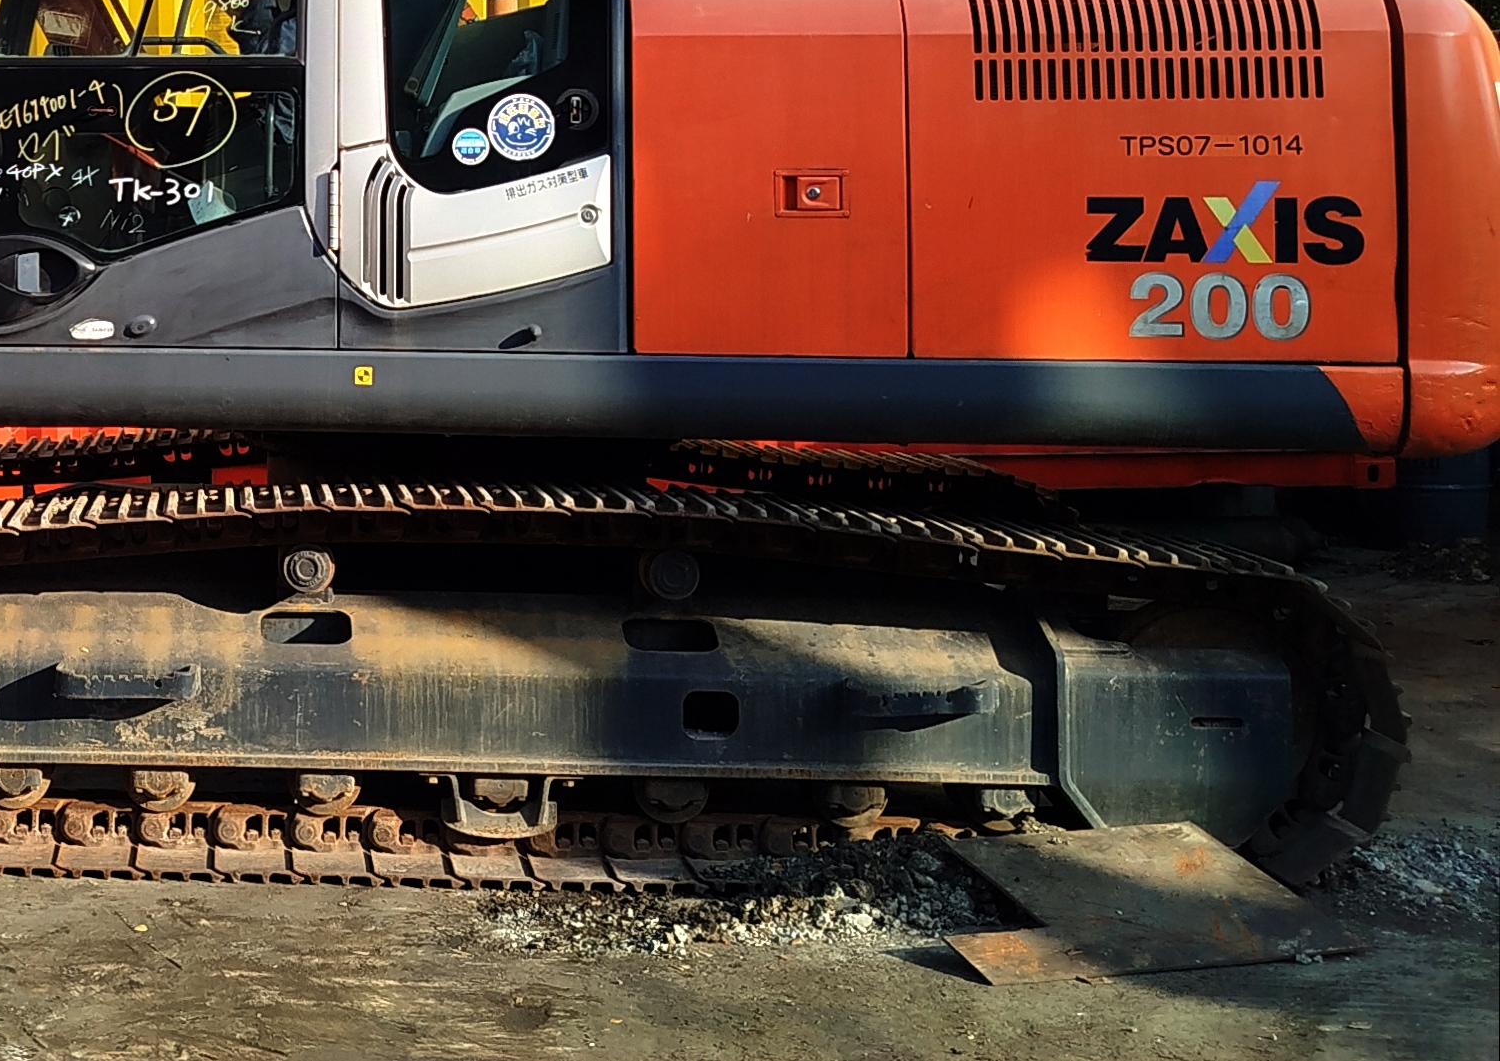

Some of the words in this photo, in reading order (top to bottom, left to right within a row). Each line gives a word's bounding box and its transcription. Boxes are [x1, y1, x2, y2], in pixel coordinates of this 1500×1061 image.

[153, 84, 211, 137] 57
[1119, 134, 1303, 156] TPS07-1014
[1086, 180, 1365, 266] ZAXIS
[1128, 271, 1312, 341] 200
